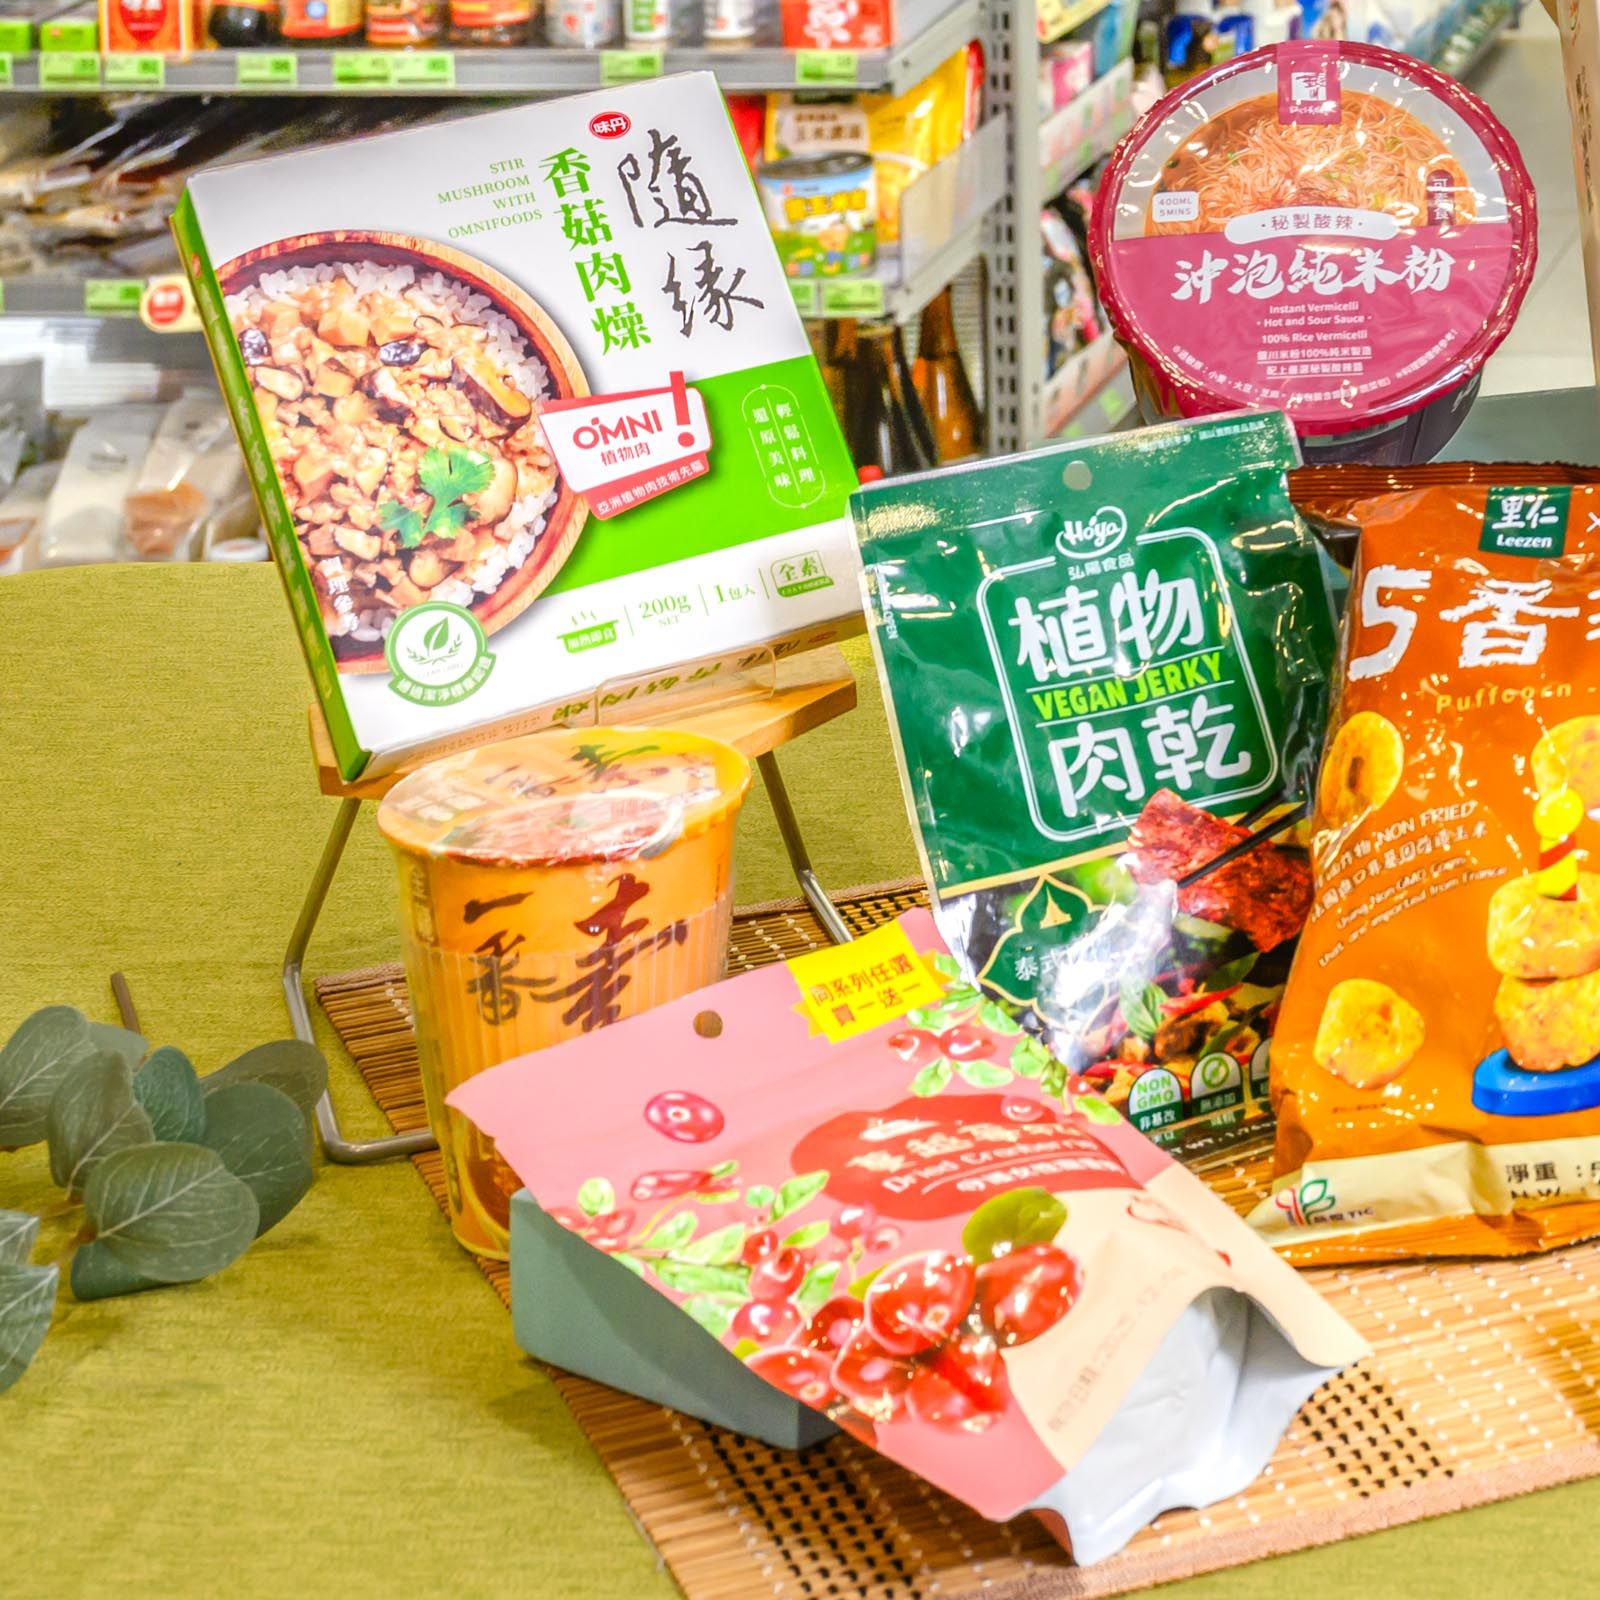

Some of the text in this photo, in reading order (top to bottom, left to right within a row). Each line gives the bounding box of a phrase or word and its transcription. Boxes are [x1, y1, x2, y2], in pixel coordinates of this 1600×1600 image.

[591, 117, 629, 138] 味丹
[489, 156, 526, 176] STIR
[437, 173, 532, 206] MUSHROOM
[491, 190, 538, 211] WITH
[447, 207, 543, 241] OMNIFOODS
[1159, 207, 1192, 218] 5MINS
[1270, 213, 1354, 232] 秘製酸辣
[616, 129, 765, 338] 隨緣
[539, 145, 652, 357] 香菇肉燥
[1169, 244, 1456, 304] 沖泡純米粉
[1263, 314, 1366, 328] Hot and Sour Sauce
[1269, 301, 1359, 315] Instant Vermicelli
[1261, 330, 1368, 344] 100% Rice Vermicelli
[599, 441, 652, 467] 植物肉
[1491, 494, 1560, 531] 里仁
[1496, 533, 1554, 549] Leezen
[779, 556, 820, 582] 全素
[712, 581, 757, 604] 1包入
[638, 593, 692, 620] 200g
[1009, 567, 1207, 684] 植物
[1032, 649, 1225, 724] VEGAN JERKY
[1436, 678, 1575, 714] Puffcorn
[1047, 694, 1253, 820] 肉乾
[1419, 799, 1479, 828] FRIED
[808, 950, 916, 1012] 同系列任選
[830, 978, 925, 1034] 買一送一
[1136, 1074, 1173, 1096] NON
[1136, 1090, 1176, 1112] GMO
